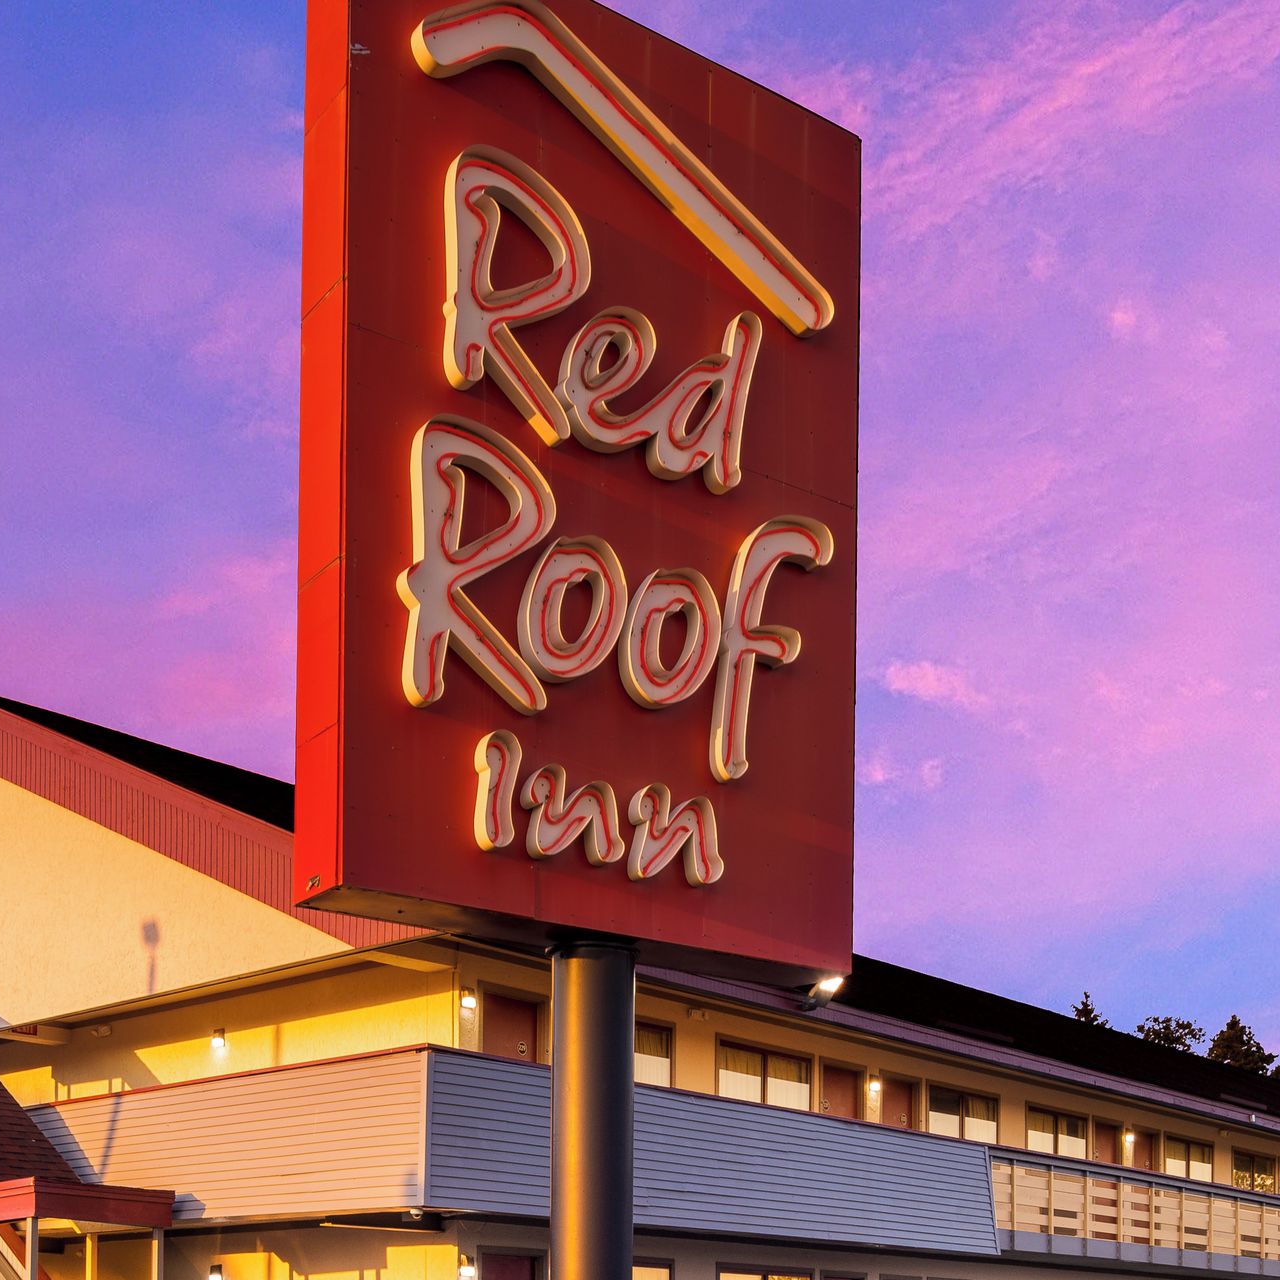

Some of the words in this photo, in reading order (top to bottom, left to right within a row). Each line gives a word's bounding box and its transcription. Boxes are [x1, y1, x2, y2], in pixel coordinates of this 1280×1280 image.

[443, 144, 763, 495] Red
[396, 412, 834, 783] Roof
[473, 729, 725, 887] Inn
